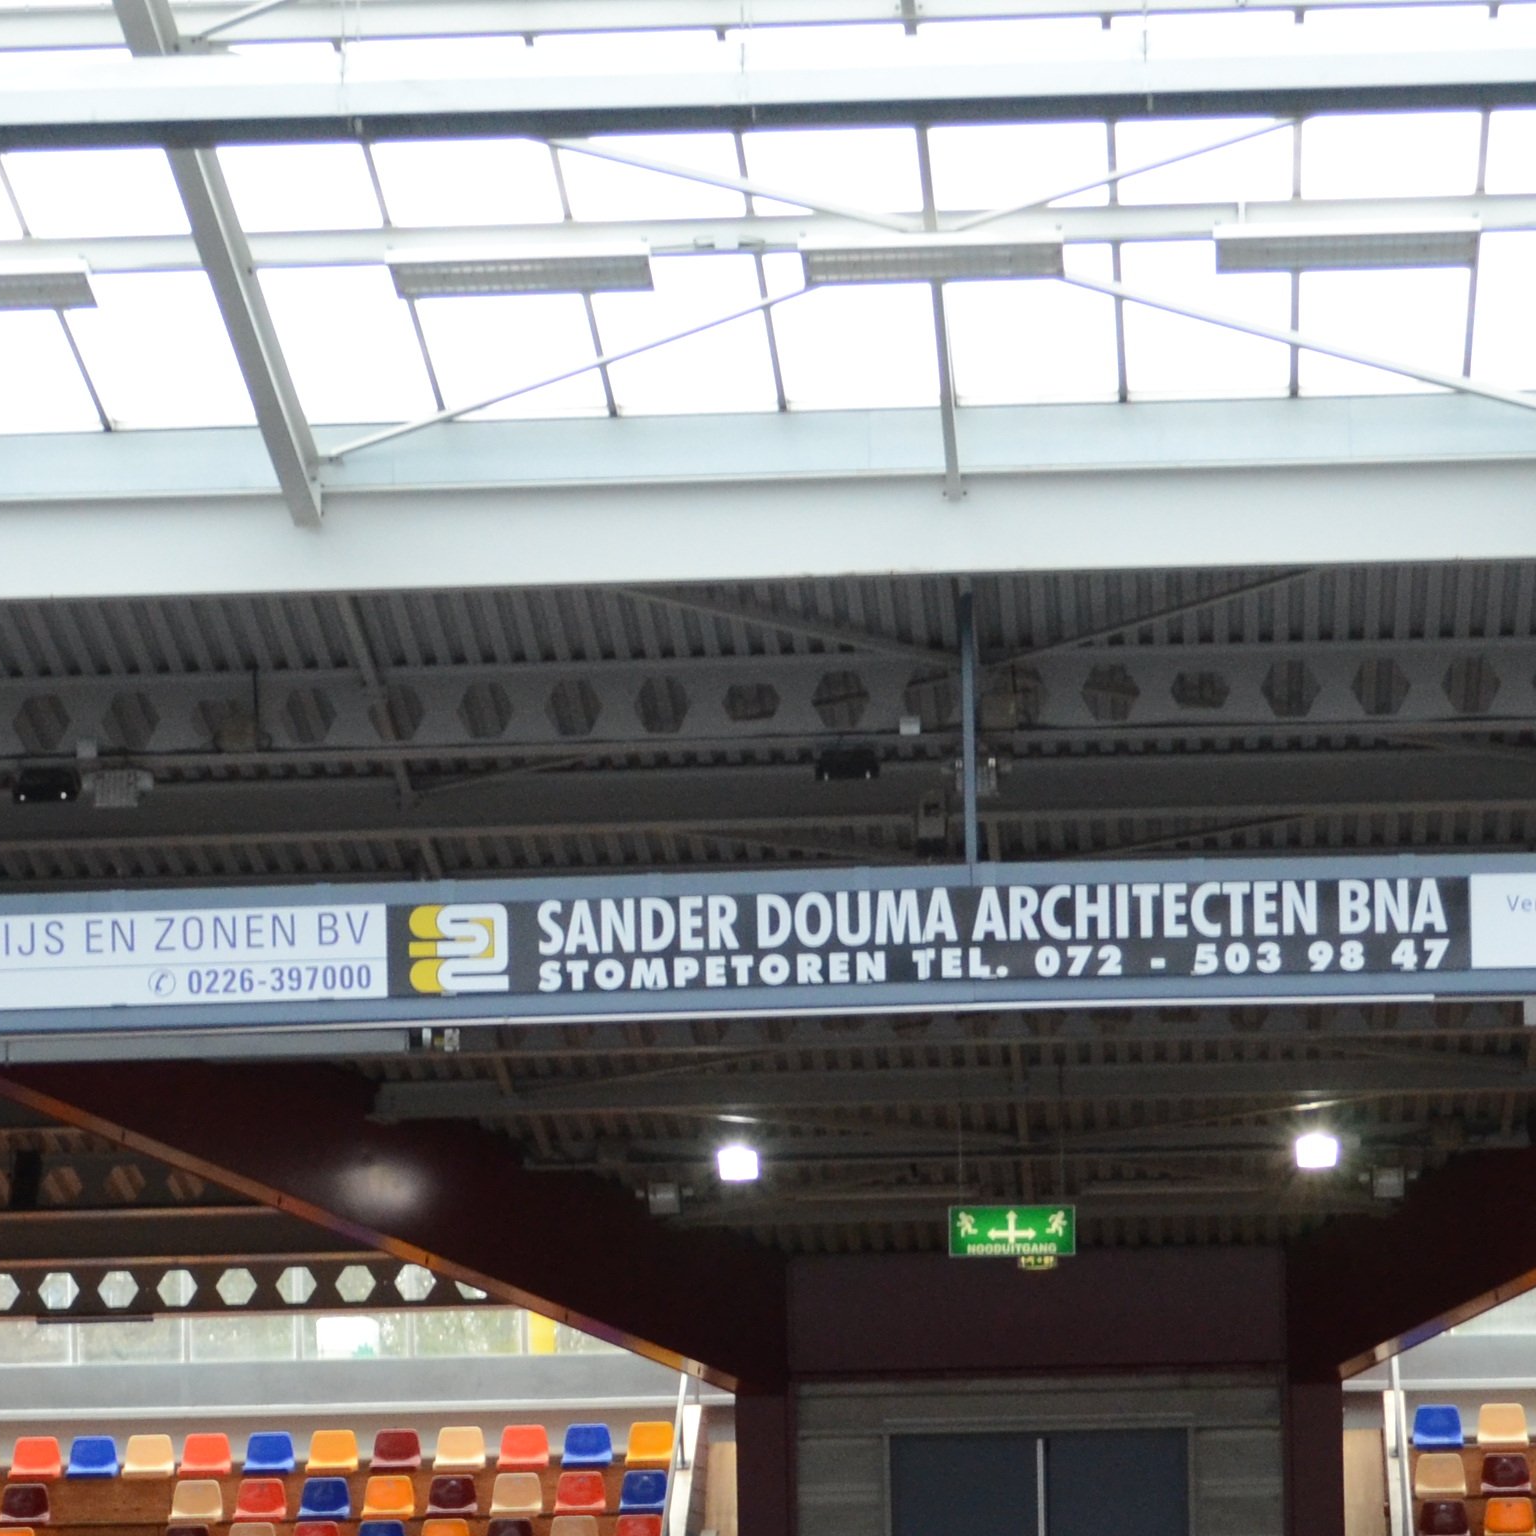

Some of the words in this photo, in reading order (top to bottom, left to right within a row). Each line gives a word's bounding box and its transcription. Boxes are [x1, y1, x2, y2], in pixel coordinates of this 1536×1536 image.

[85, 915, 137, 954] EN
[154, 912, 298, 951] ZONEN
[316, 911, 371, 947] BV
[536, 894, 739, 956] SANDER
[757, 886, 958, 949] DOUMA
[972, 880, 1319, 942] ARCHITECTEN
[1338, 878, 1449, 934] BNA
[187, 964, 372, 994] 0226-397000
[538, 949, 887, 993] STOMPETOREN
[912, 945, 1010, 982] TEL.
[1035, 945, 1122, 977] 072
[1192, 941, 1283, 976] 503
[1308, 941, 1365, 971] 98
[1392, 939, 1450, 970] 47
